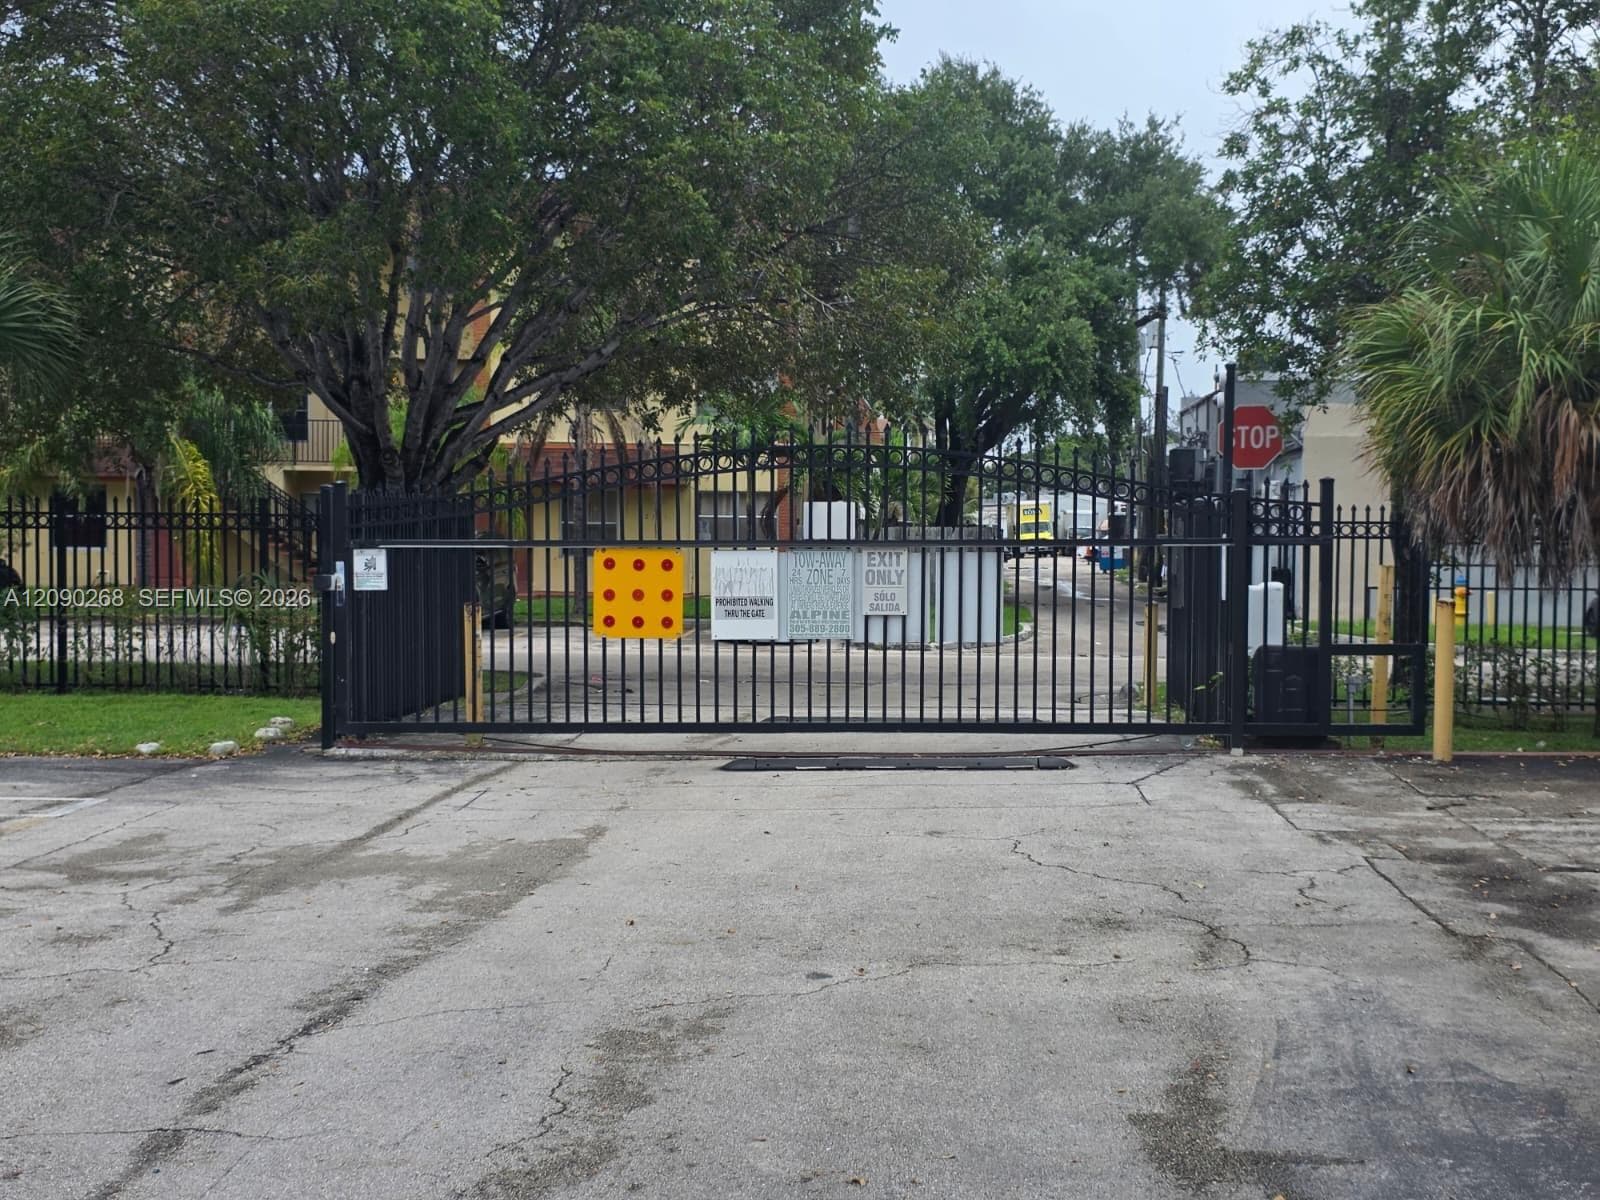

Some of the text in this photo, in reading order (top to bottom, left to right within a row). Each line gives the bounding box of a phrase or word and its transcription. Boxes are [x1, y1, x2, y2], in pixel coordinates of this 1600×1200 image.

[1233, 425, 1279, 449] TOP
[793, 551, 847, 568] TOW-AWAY
[867, 551, 903, 567] EXIT
[791, 568, 801, 577] 24
[806, 568, 834, 585] ZONE
[865, 569, 904, 585] ONLY
[836, 576, 851, 585] DAYS
[715, 598, 774, 607] PROHIBITED WALKING
[869, 602, 901, 611] SALIDA
[724, 609, 766, 618] THRU THE GATE
[790, 610, 850, 619] ALPINE
